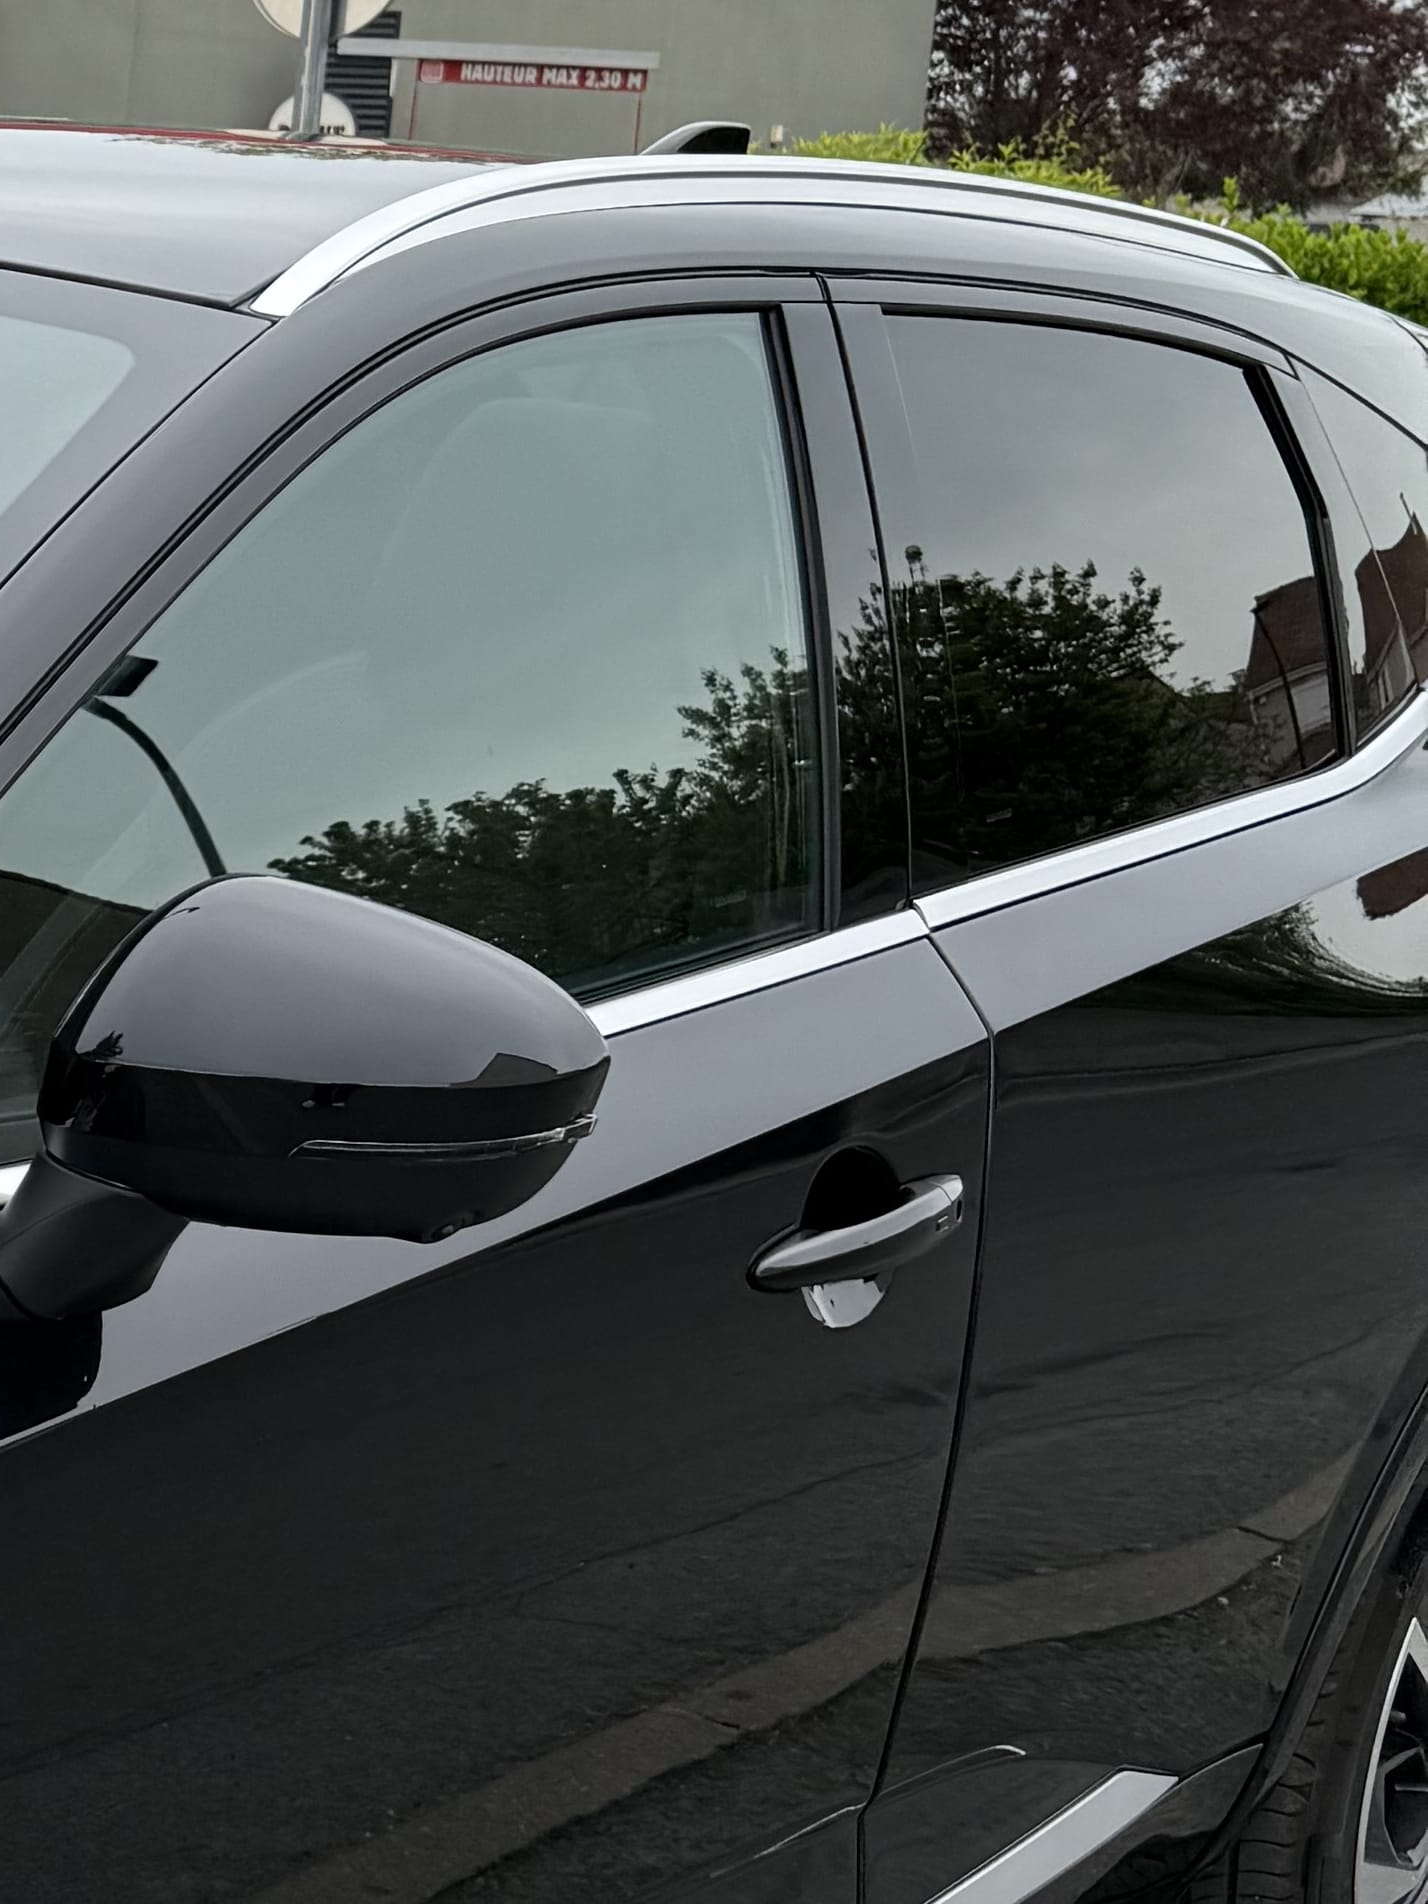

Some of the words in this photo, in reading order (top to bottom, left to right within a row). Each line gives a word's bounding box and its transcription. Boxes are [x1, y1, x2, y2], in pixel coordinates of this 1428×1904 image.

[460, 63, 538, 85] HAUTEUR
[542, 67, 580, 86] MAX
[626, 72, 643, 91] M
